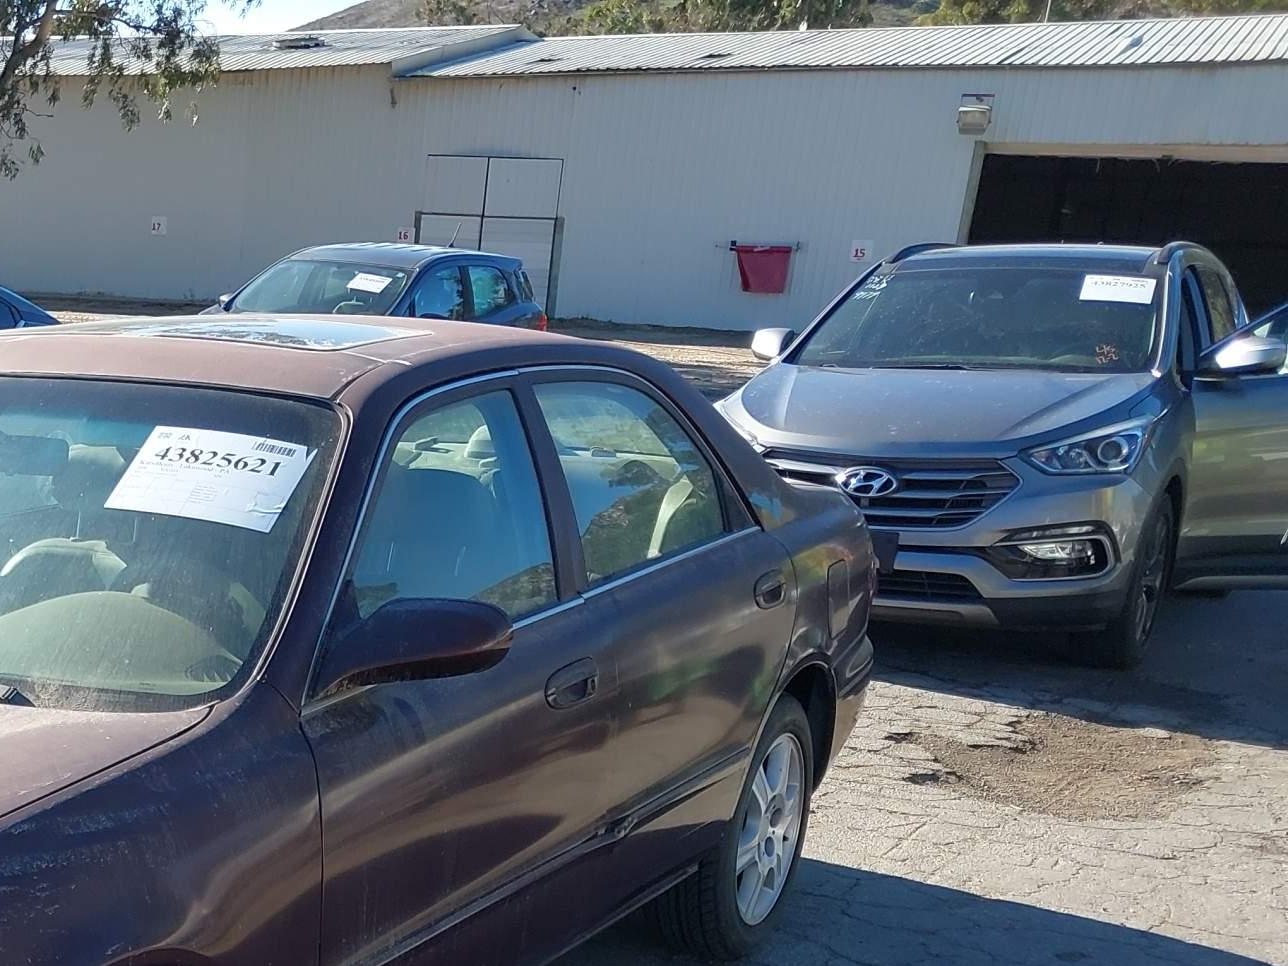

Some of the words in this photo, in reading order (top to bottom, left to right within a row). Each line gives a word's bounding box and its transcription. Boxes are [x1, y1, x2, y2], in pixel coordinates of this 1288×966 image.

[152, 222, 161, 231] 17
[398, 231, 409, 240] 16
[853, 248, 866, 258] 15
[154, 445, 283, 477] 43825621
